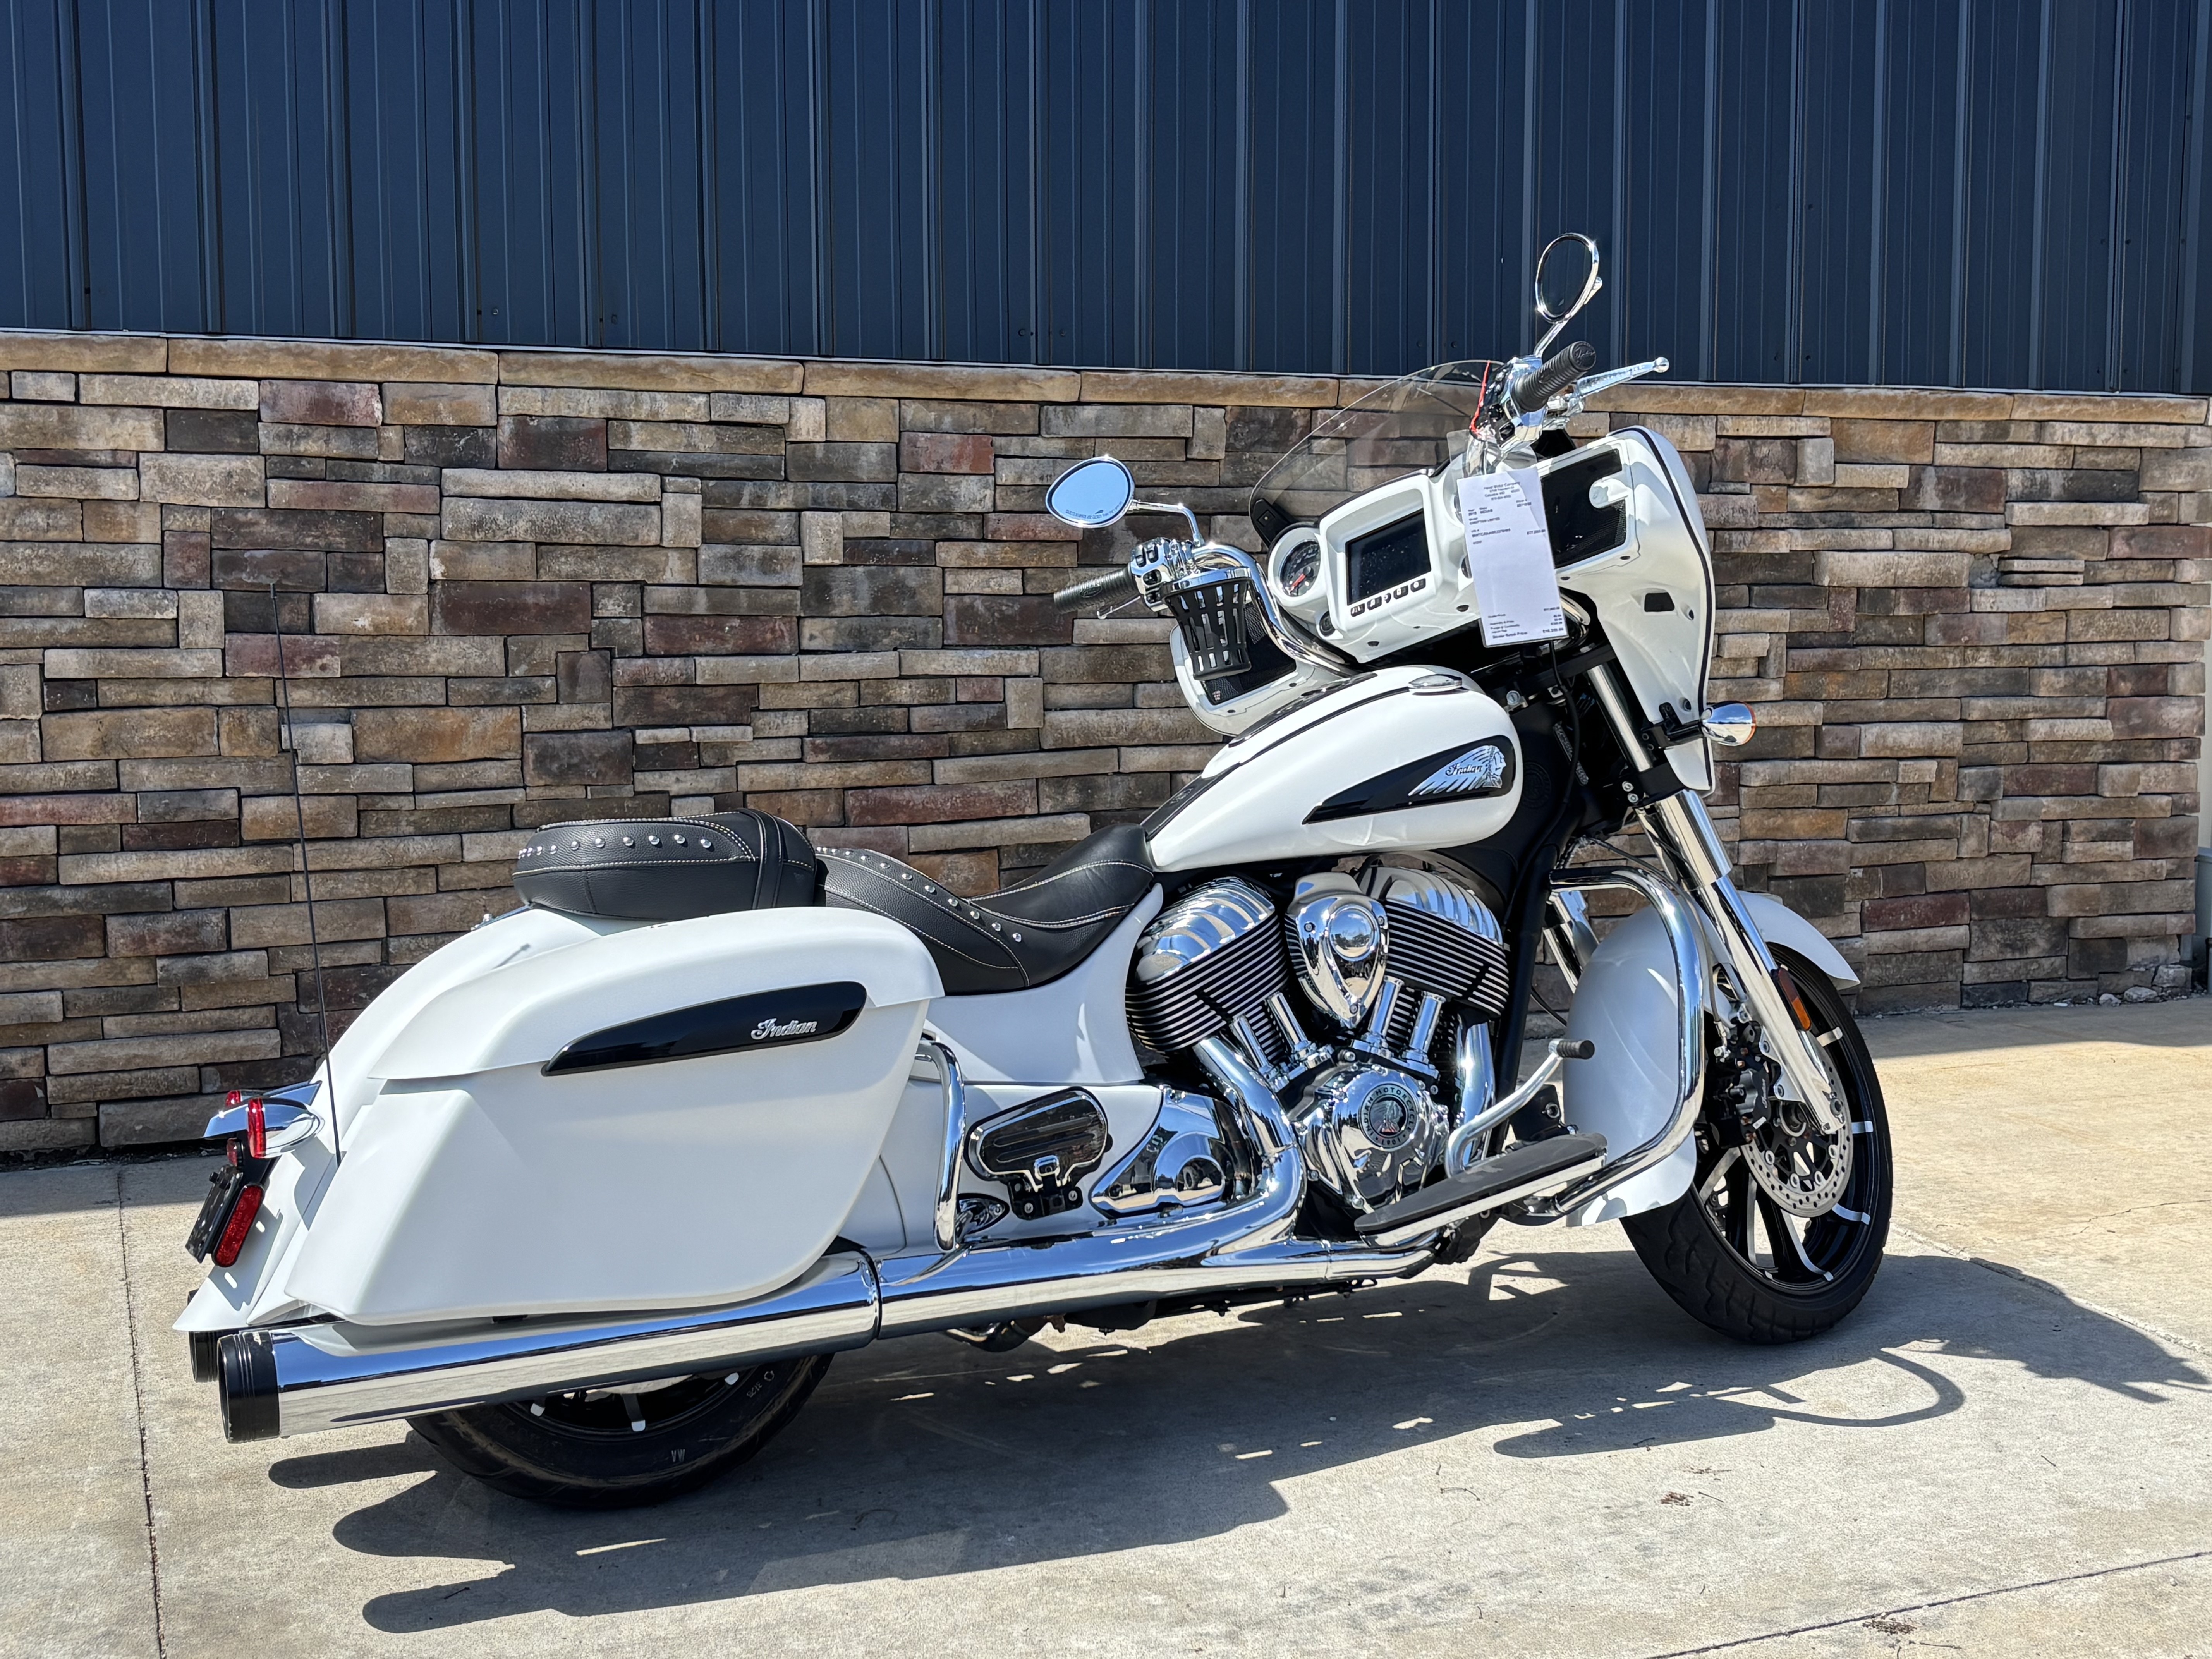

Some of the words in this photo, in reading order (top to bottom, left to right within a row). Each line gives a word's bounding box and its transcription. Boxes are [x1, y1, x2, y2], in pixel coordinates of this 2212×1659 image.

[1445, 762, 1482, 776] Indian
[751, 1018, 817, 1040] Indian
[1363, 1096, 1374, 1136] INDIAN
[1376, 1087, 1415, 1132] MOTORCYCLE
